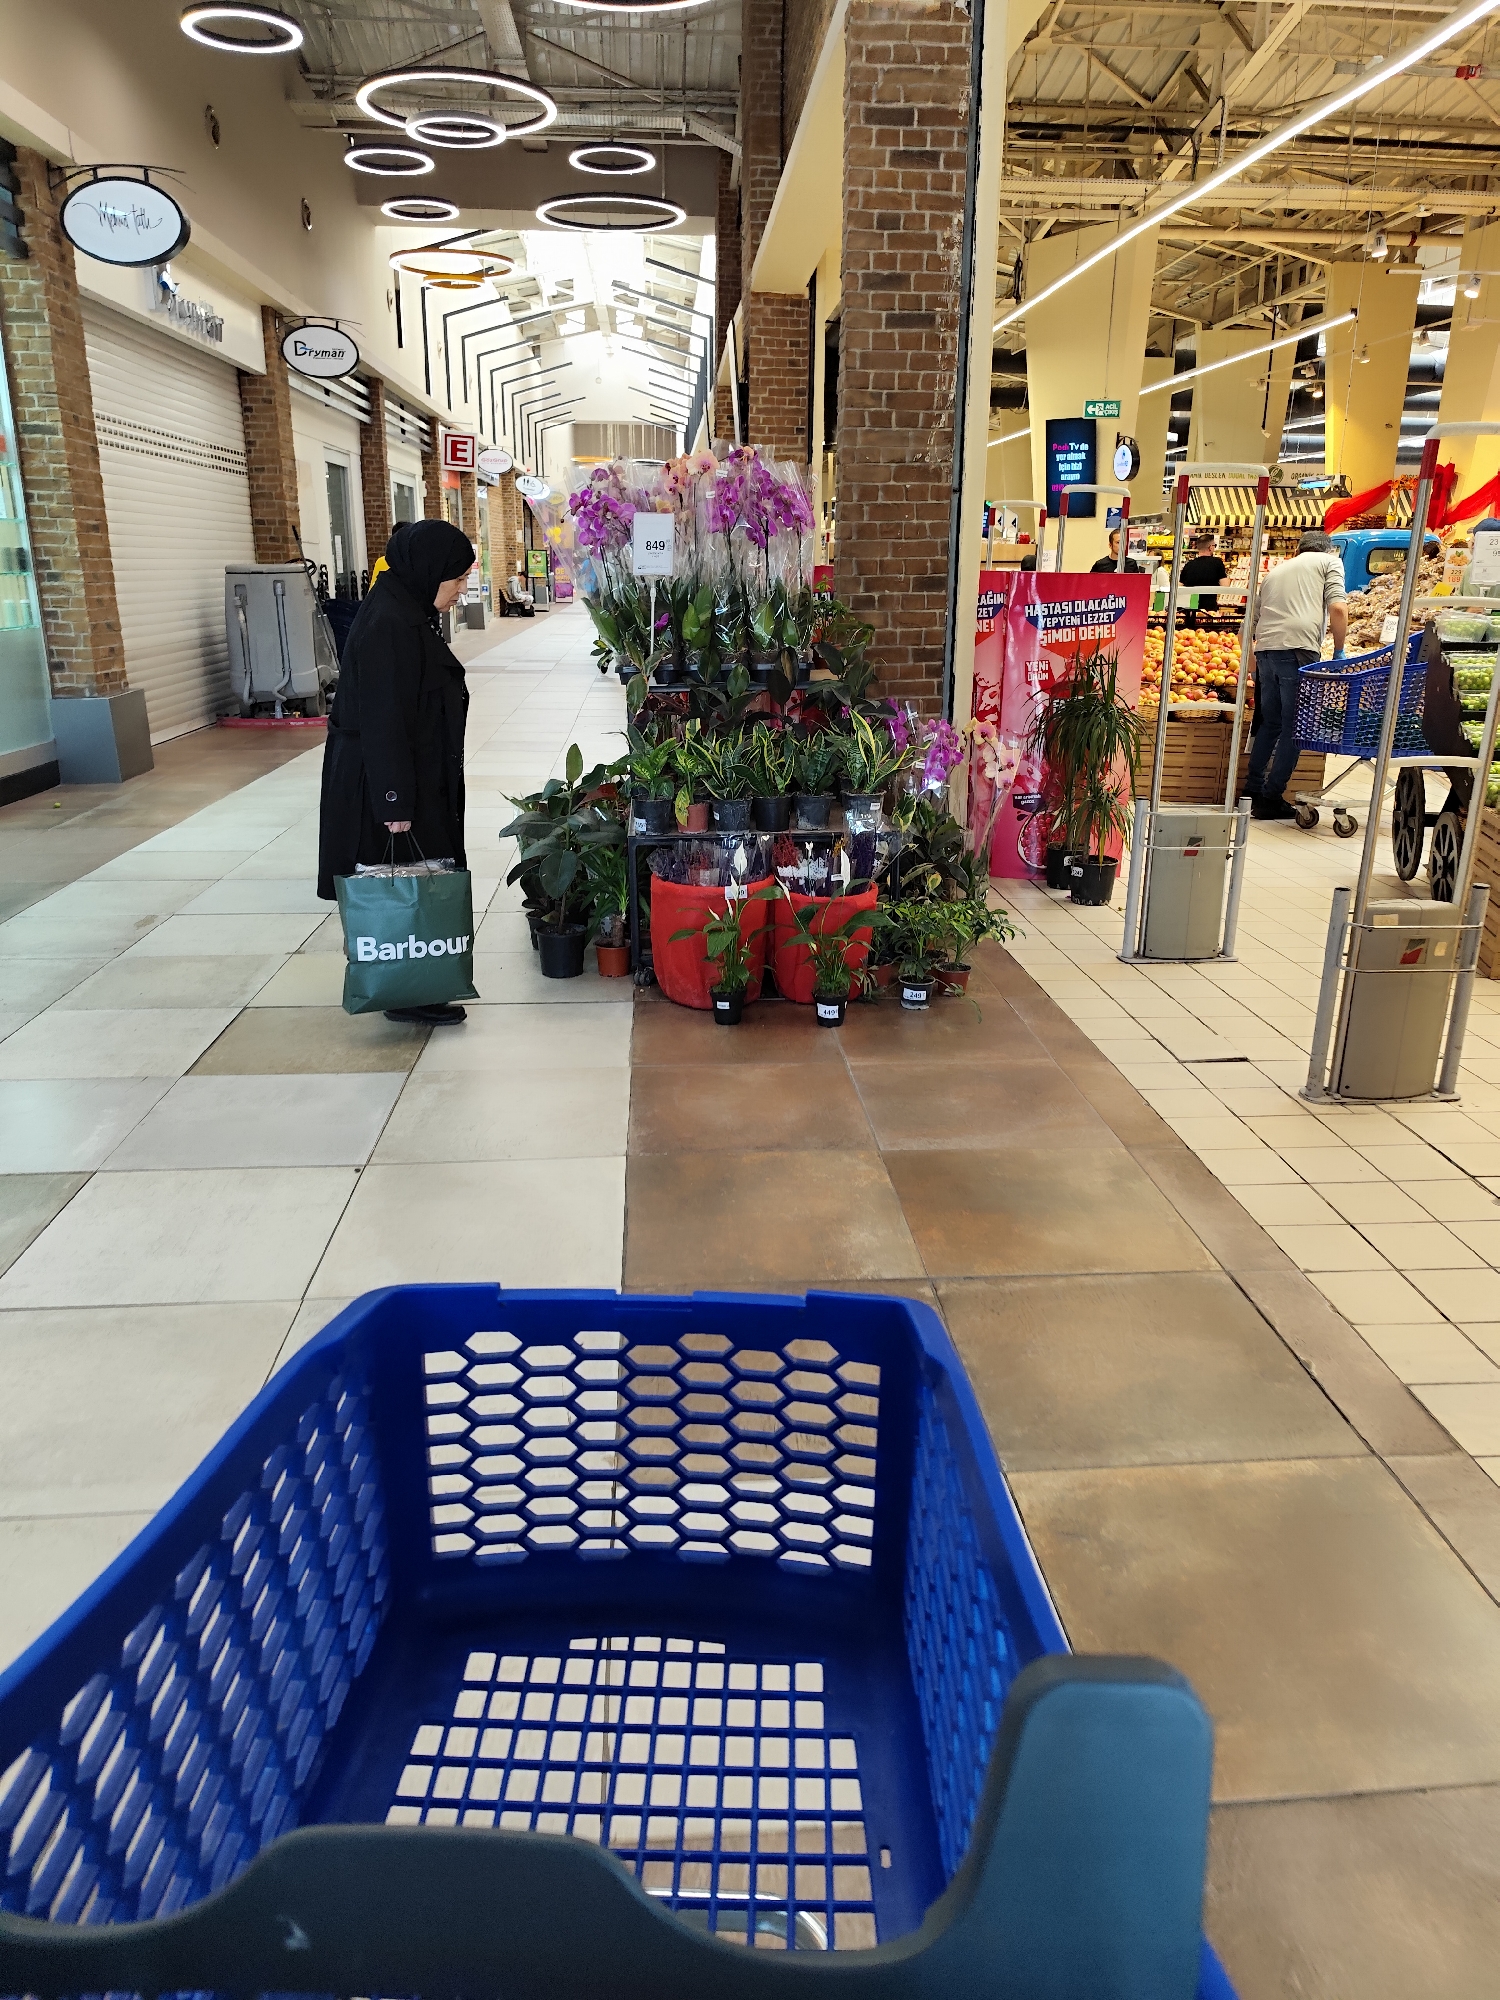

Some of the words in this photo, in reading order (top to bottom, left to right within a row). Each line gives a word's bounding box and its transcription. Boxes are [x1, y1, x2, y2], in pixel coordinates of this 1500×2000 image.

[294, 341, 346, 359] Dryman
[451, 440, 468, 462] E
[645, 540, 666, 551] 849
[1025, 601, 1072, 618] HASTASI
[1075, 594, 1126, 613] OLACAĞIN
[1082, 611, 1116, 624] LEZZET
[1039, 627, 1076, 646] ŞİMDİ
[1078, 624, 1116, 641] DENE!
[356, 934, 470, 962] Barbour
